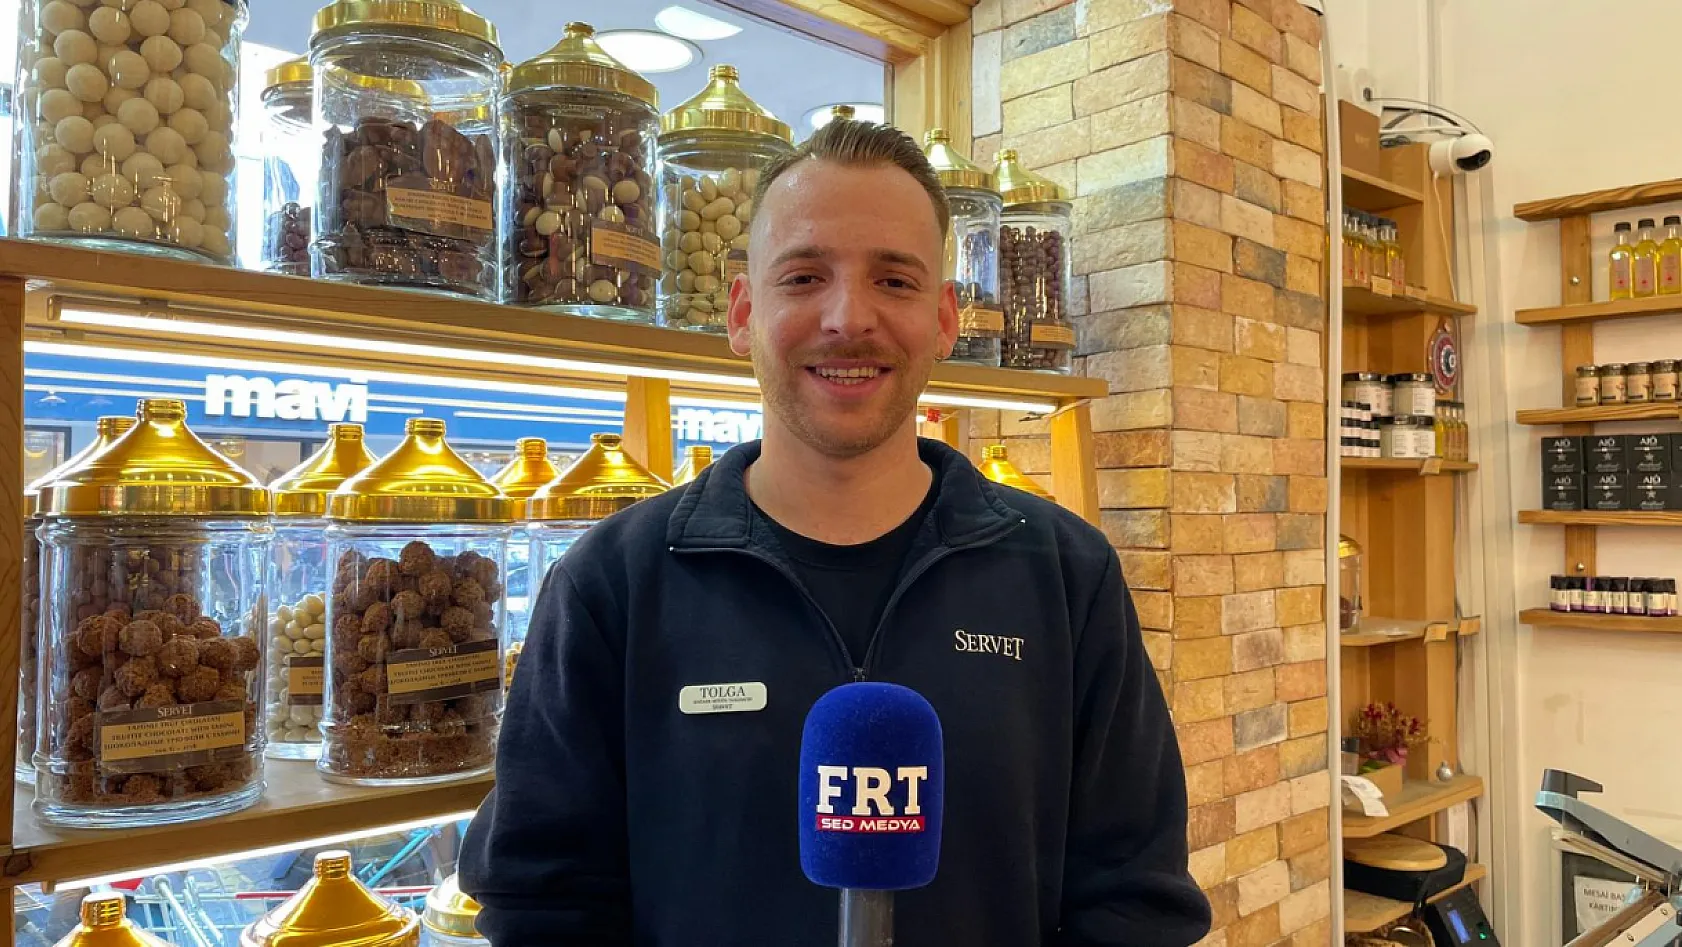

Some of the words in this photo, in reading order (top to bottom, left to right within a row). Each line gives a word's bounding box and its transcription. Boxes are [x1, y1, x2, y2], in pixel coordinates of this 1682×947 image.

[205, 374, 368, 422] mavi
[677, 408, 763, 443] mav
[955, 629, 1025, 661] SERVET
[700, 686, 746, 698] TOLGA
[816, 765, 928, 816] FRT
[821, 818, 855, 831] SED
[859, 819, 921, 832] MEDYA
